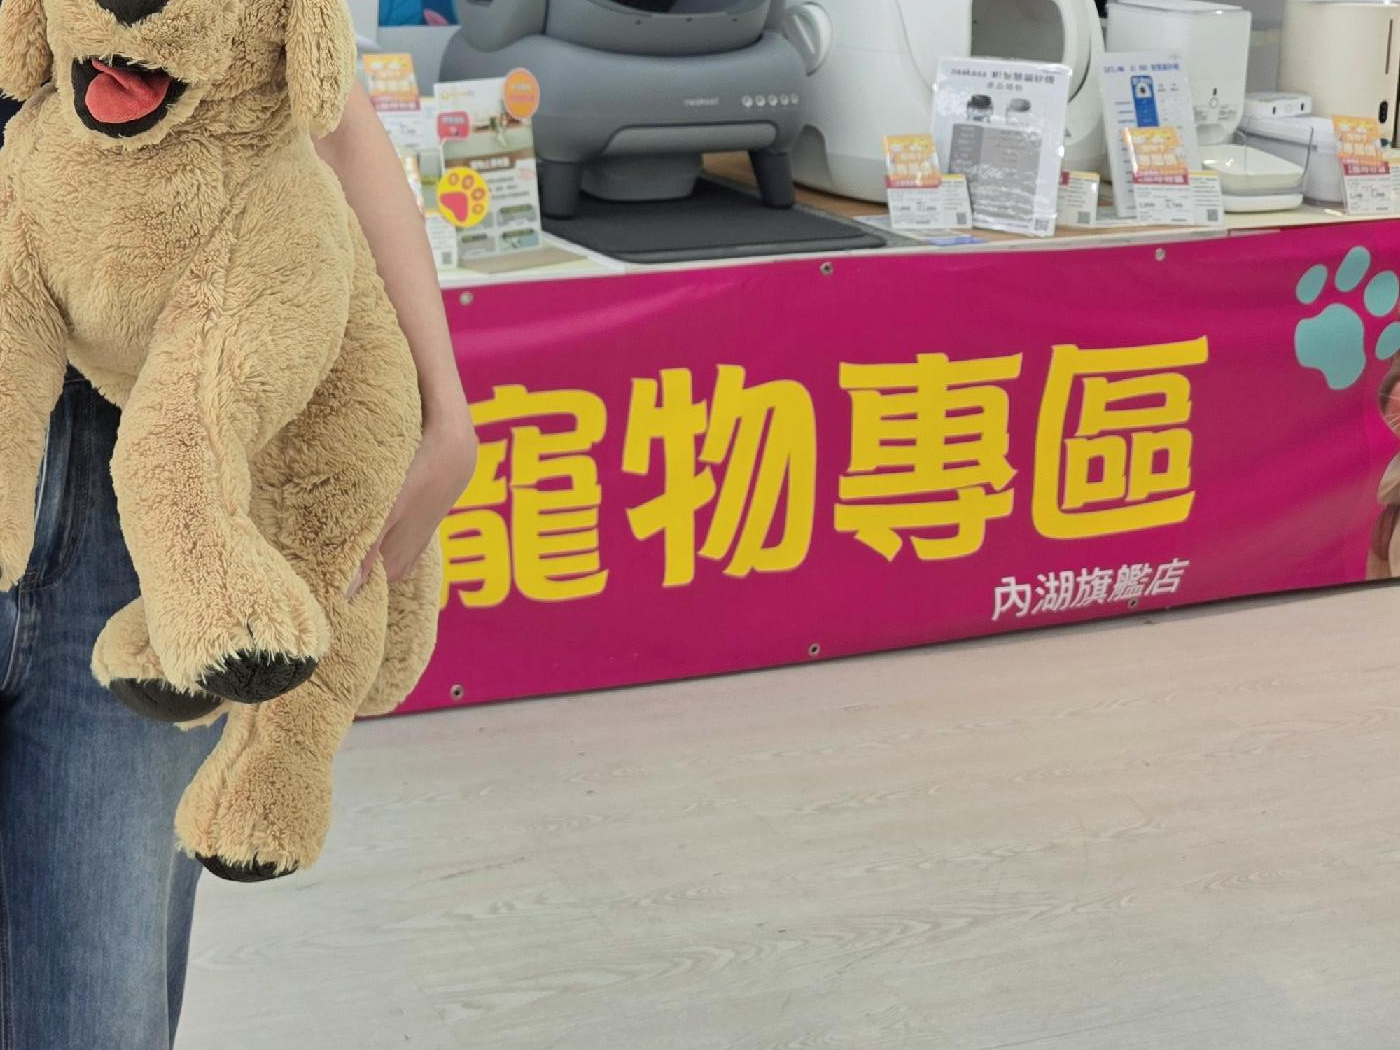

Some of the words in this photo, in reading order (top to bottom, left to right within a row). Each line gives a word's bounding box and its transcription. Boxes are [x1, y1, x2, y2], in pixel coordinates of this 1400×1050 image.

[439, 335, 1209, 610] 寵物專區
[989, 557, 1190, 624] 內湖旗艦店
